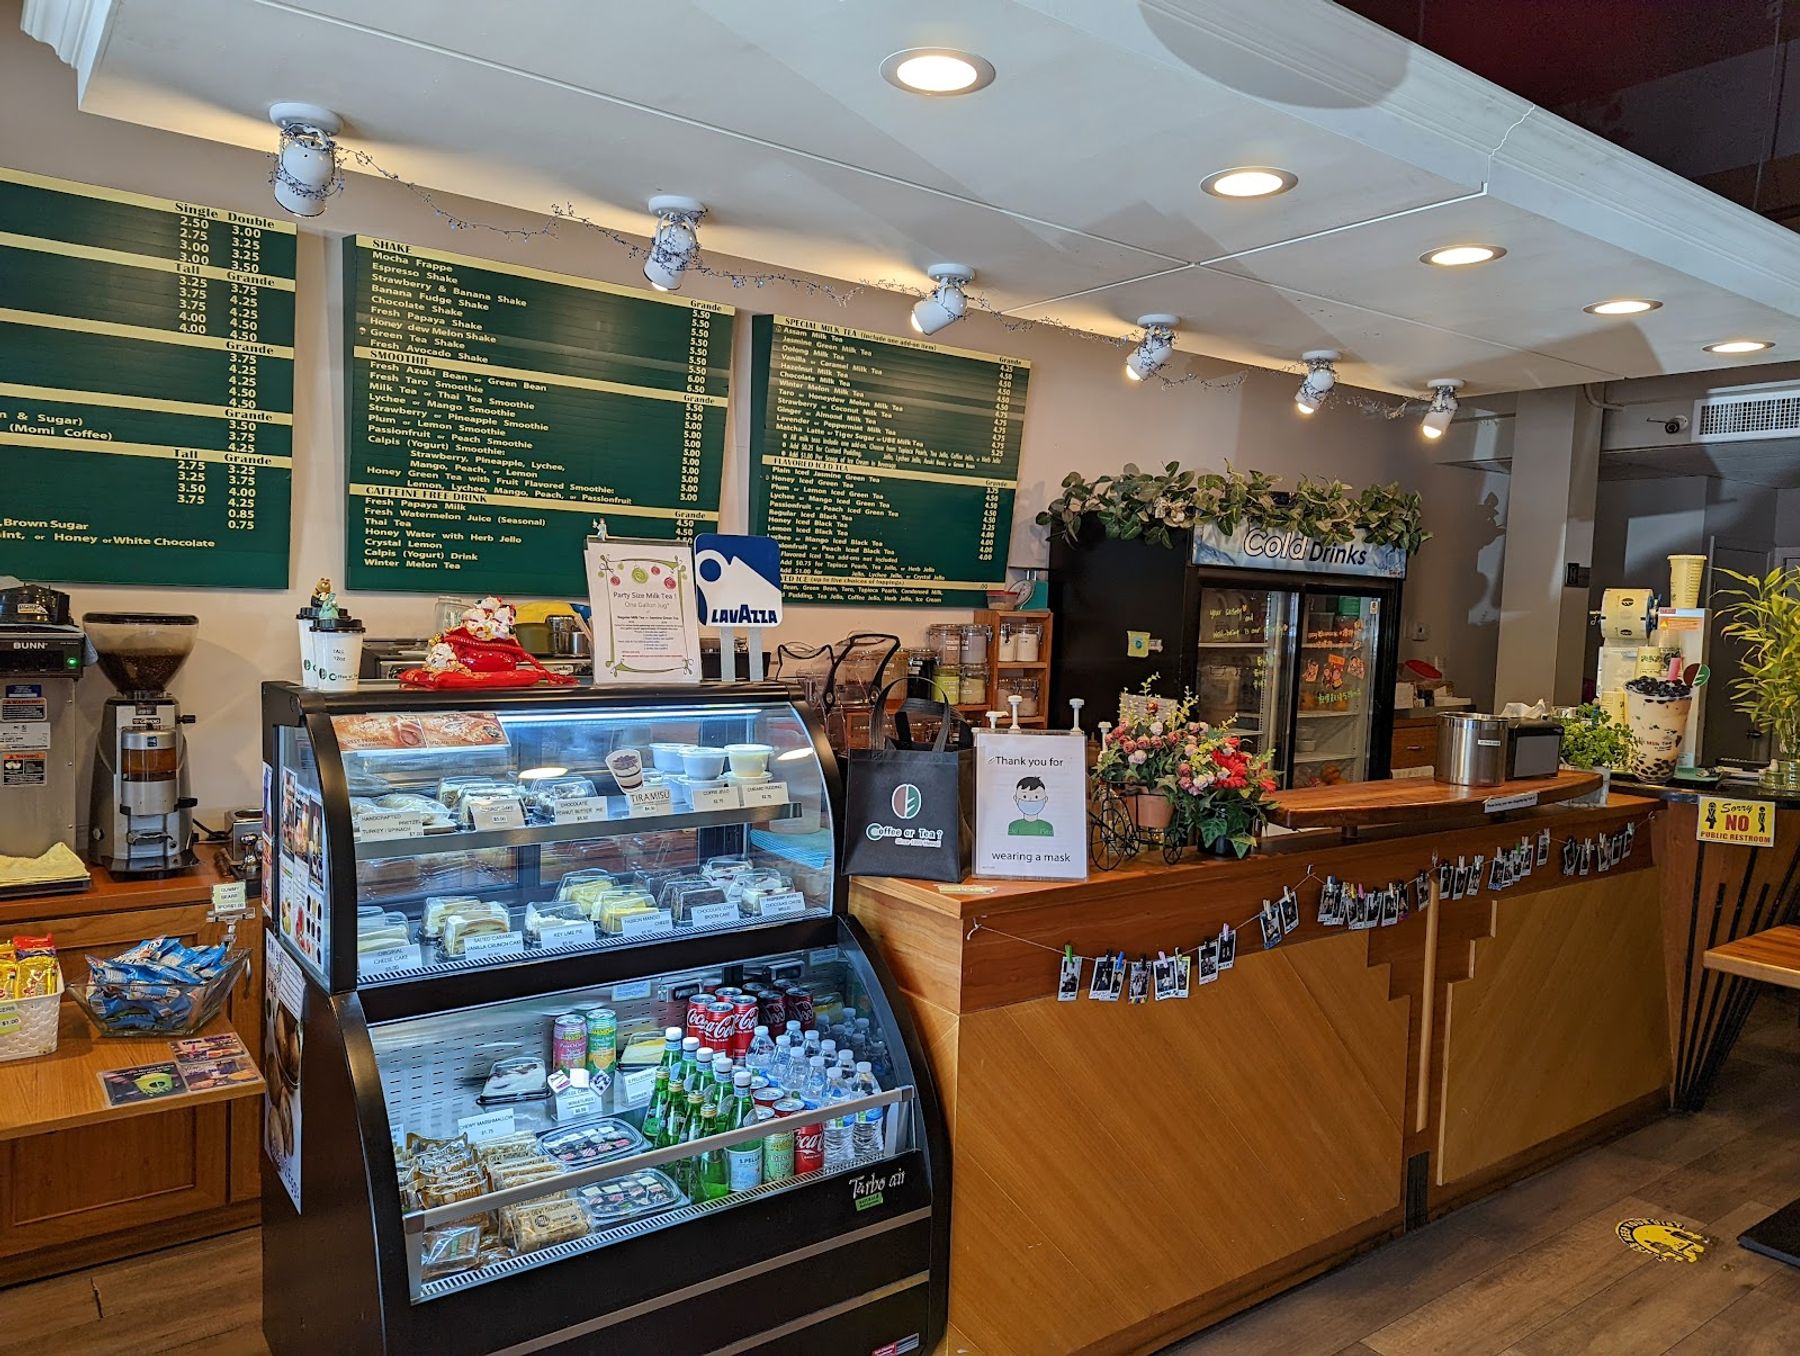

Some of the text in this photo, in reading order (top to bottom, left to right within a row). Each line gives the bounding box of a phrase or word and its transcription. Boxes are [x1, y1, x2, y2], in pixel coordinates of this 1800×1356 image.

[175, 203, 274, 228] Single Double
[180, 215, 261, 238] 2.50 3.00
[175, 262, 274, 286] Tall Grande
[373, 240, 721, 311] SHAKE Grande
[179, 275, 257, 296] 3.25 3.75
[372, 251, 710, 319] Mocha Frappe 5.50
[372, 273, 526, 306] Strawberry & Banana Shake
[370, 328, 705, 384] Green Tea Shake 6.00
[370, 351, 714, 404] SMOOTHIE Grande
[17, 412, 28, 420] &
[37, 414, 82, 426] Sugar)
[369, 393, 406, 403] Lychee
[427, 400, 462, 411] Mango
[469, 405, 515, 417] Smoothie
[683, 430, 702, 439] 5.00
[64, 428, 112, 441] Coffee)
[368, 435, 505, 455] Calpis (Yogurt) Smoothie:
[366, 487, 705, 519] CAFFEINE FREE DRINK Grande
[228, 509, 254, 518] 0.85
[364, 507, 693, 536] Fresh Watermelon Juice (Seasonal) 4.50
[50, 520, 88, 530] Sugar
[228, 520, 254, 530] 0.75
[54, 533, 98, 543] Honey
[113, 536, 150, 544] White
[154, 538, 215, 547] Chocolate
[365, 528, 399, 537] Honey
[405, 530, 436, 538] Water
[442, 532, 464, 540] with
[499, 535, 522, 543] Jello
[1244, 528, 1367, 565] Cold Drinks
[364, 558, 460, 569] Winter Melon Tea
[614, 592, 630, 600] Party
[712, 604, 778, 624] LAVAZZA
[13, 642, 45, 650] BUNN
[996, 756, 1064, 768] Thank you for
[630, 790, 670, 803] TIRAMISU
[1721, 803, 1753, 814] Sorry
[866, 822, 902, 841] Coffee
[904, 828, 915, 839] or
[918, 828, 936, 840] Tea
[1725, 814, 1750, 832] NO
[1700, 830, 1771, 844] PUBLIC RESTROOM
[992, 852, 1033, 863] wearing
[1044, 852, 1071, 862] mask
